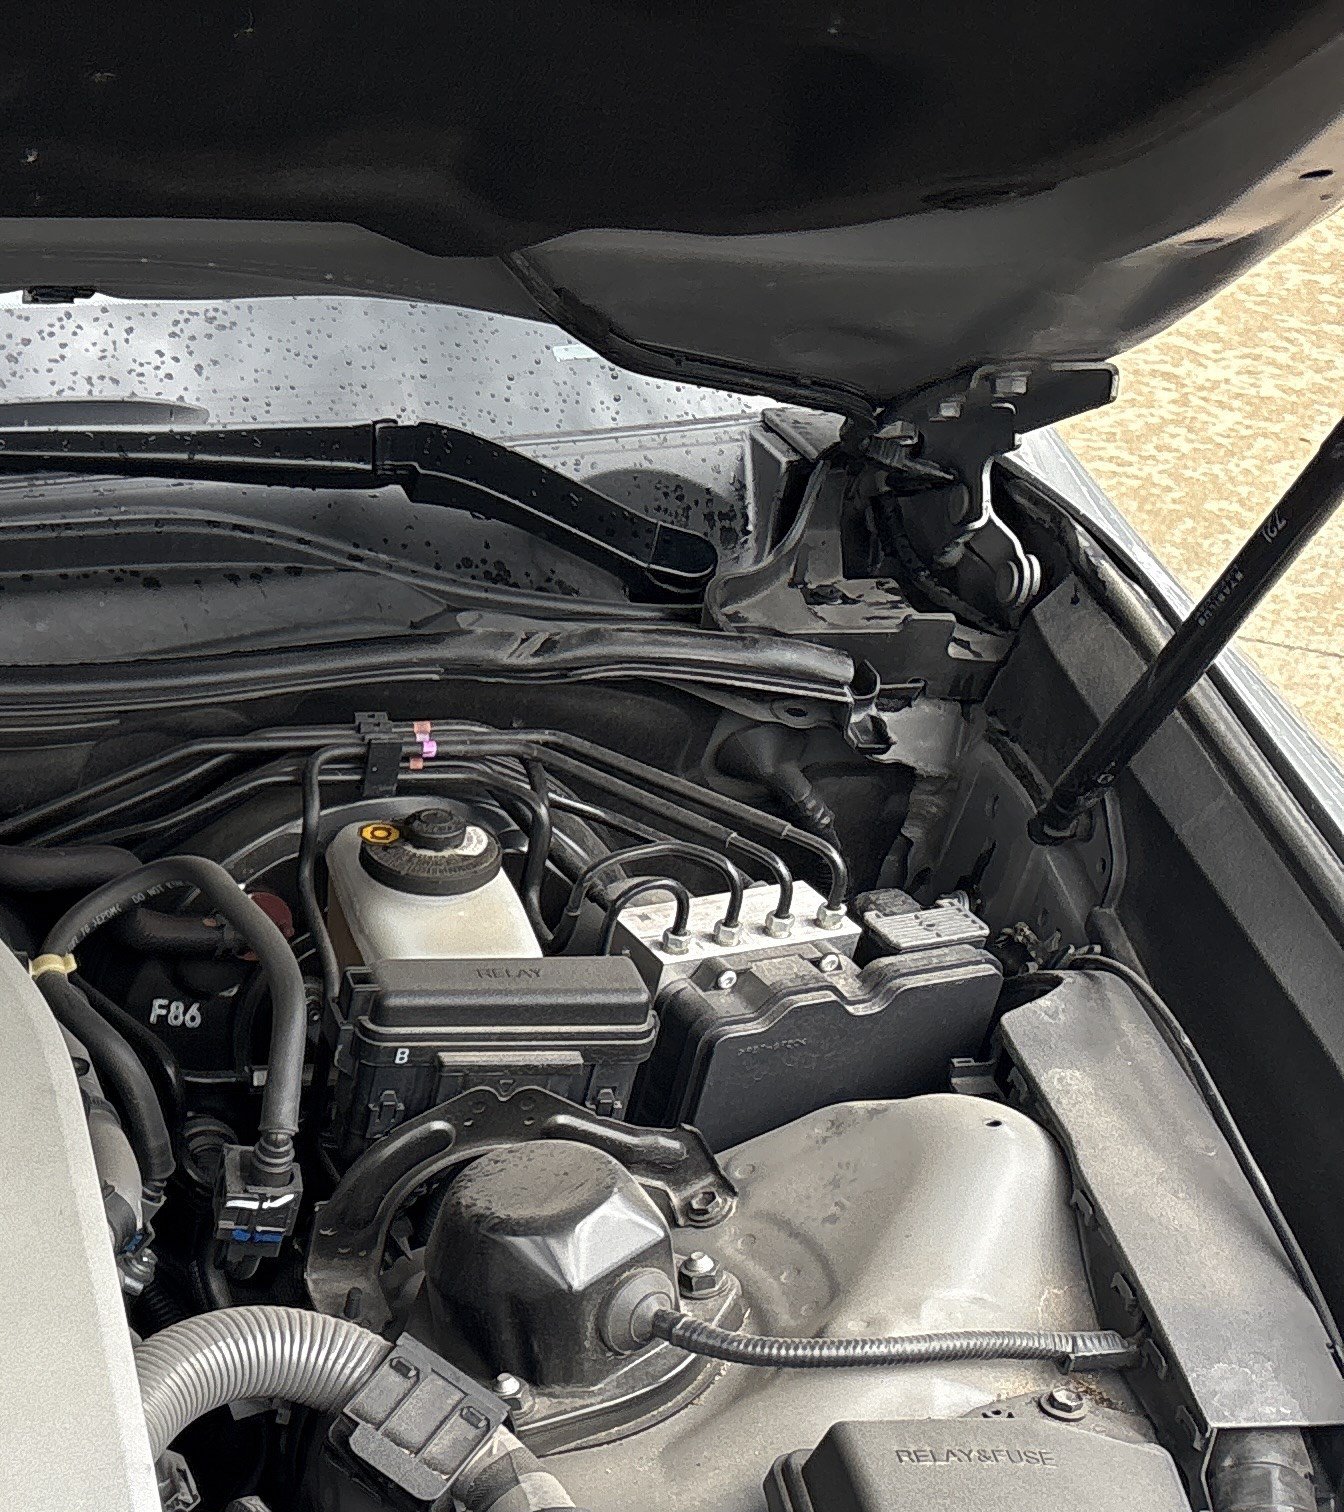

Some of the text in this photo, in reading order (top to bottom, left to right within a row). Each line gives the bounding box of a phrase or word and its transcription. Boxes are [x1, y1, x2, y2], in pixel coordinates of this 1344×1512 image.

[475, 966, 544, 979] RELAY
[148, 997, 202, 1029] F86
[394, 1047, 410, 1065] B
[895, 1447, 1057, 1469] RELAY&FUSE
